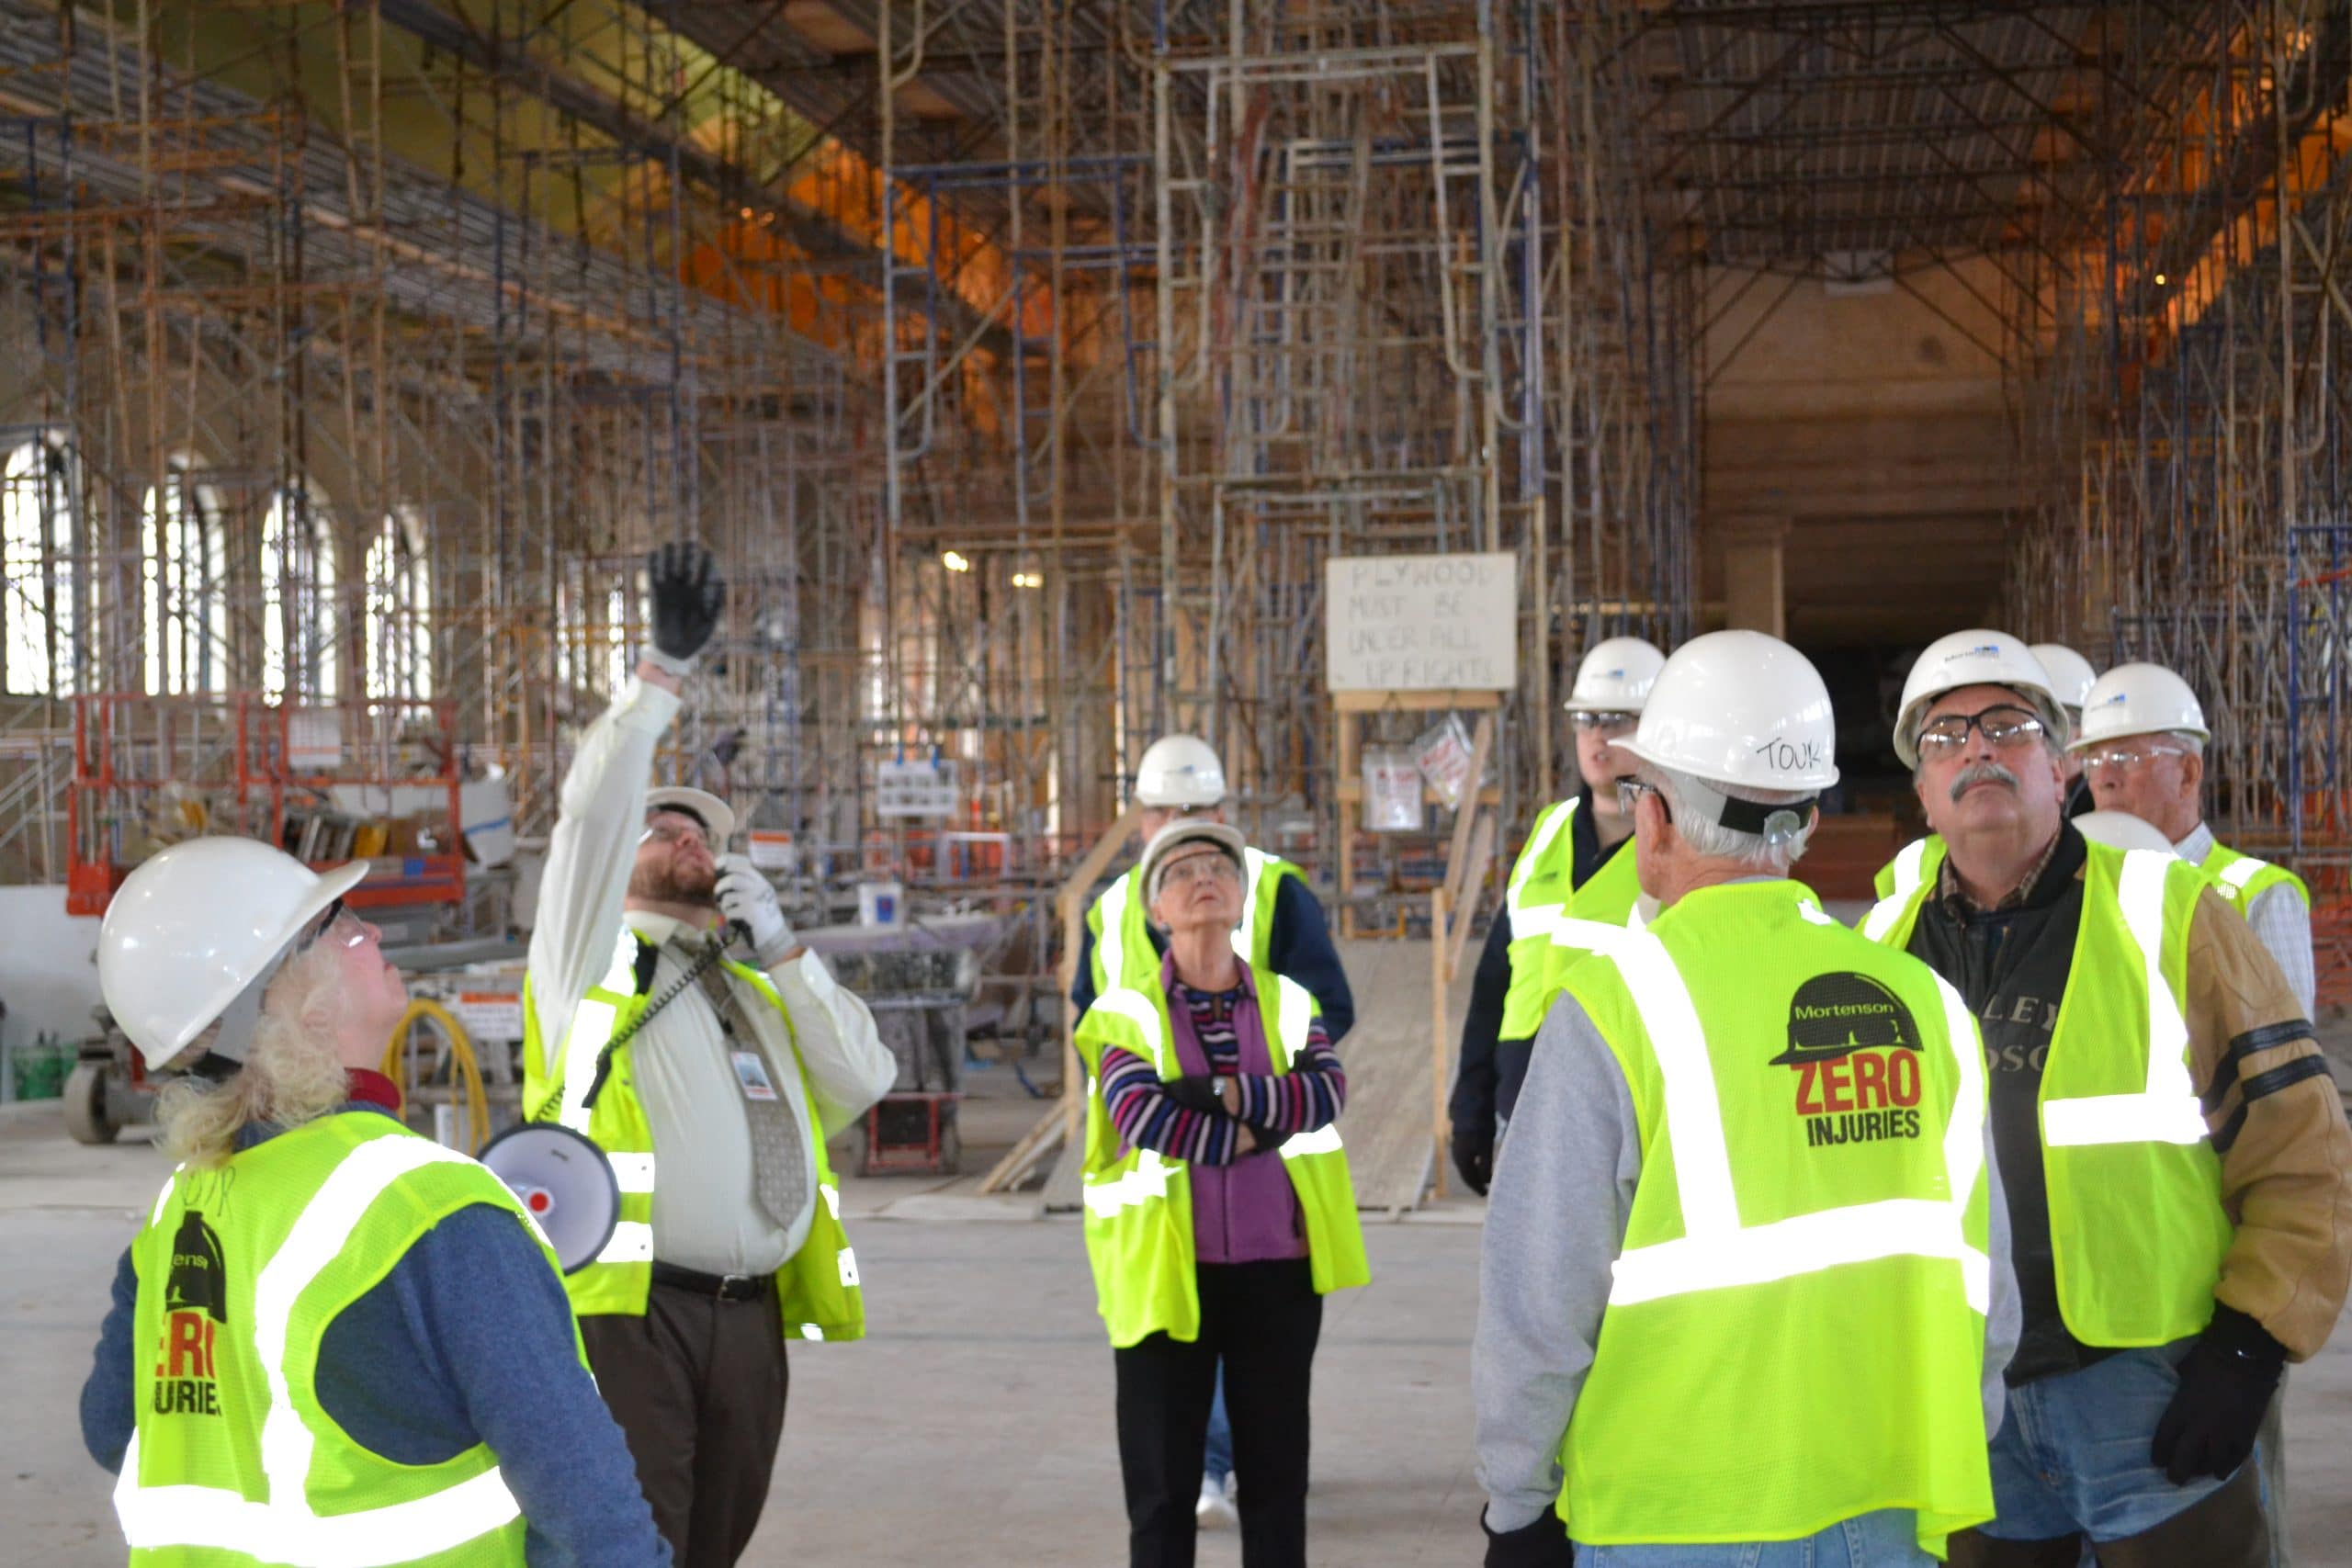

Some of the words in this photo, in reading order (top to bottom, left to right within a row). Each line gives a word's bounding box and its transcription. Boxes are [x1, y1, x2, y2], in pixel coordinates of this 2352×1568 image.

[1352, 558, 1495, 589] PLYWOOD
[1349, 595, 1408, 621] MUST
[1794, 1002, 1894, 1021] Mortenson
[1789, 1048, 1922, 1116] ZERO
[1806, 1109, 1920, 1147] INJURIES
[154, 1380, 222, 1416] URIE
